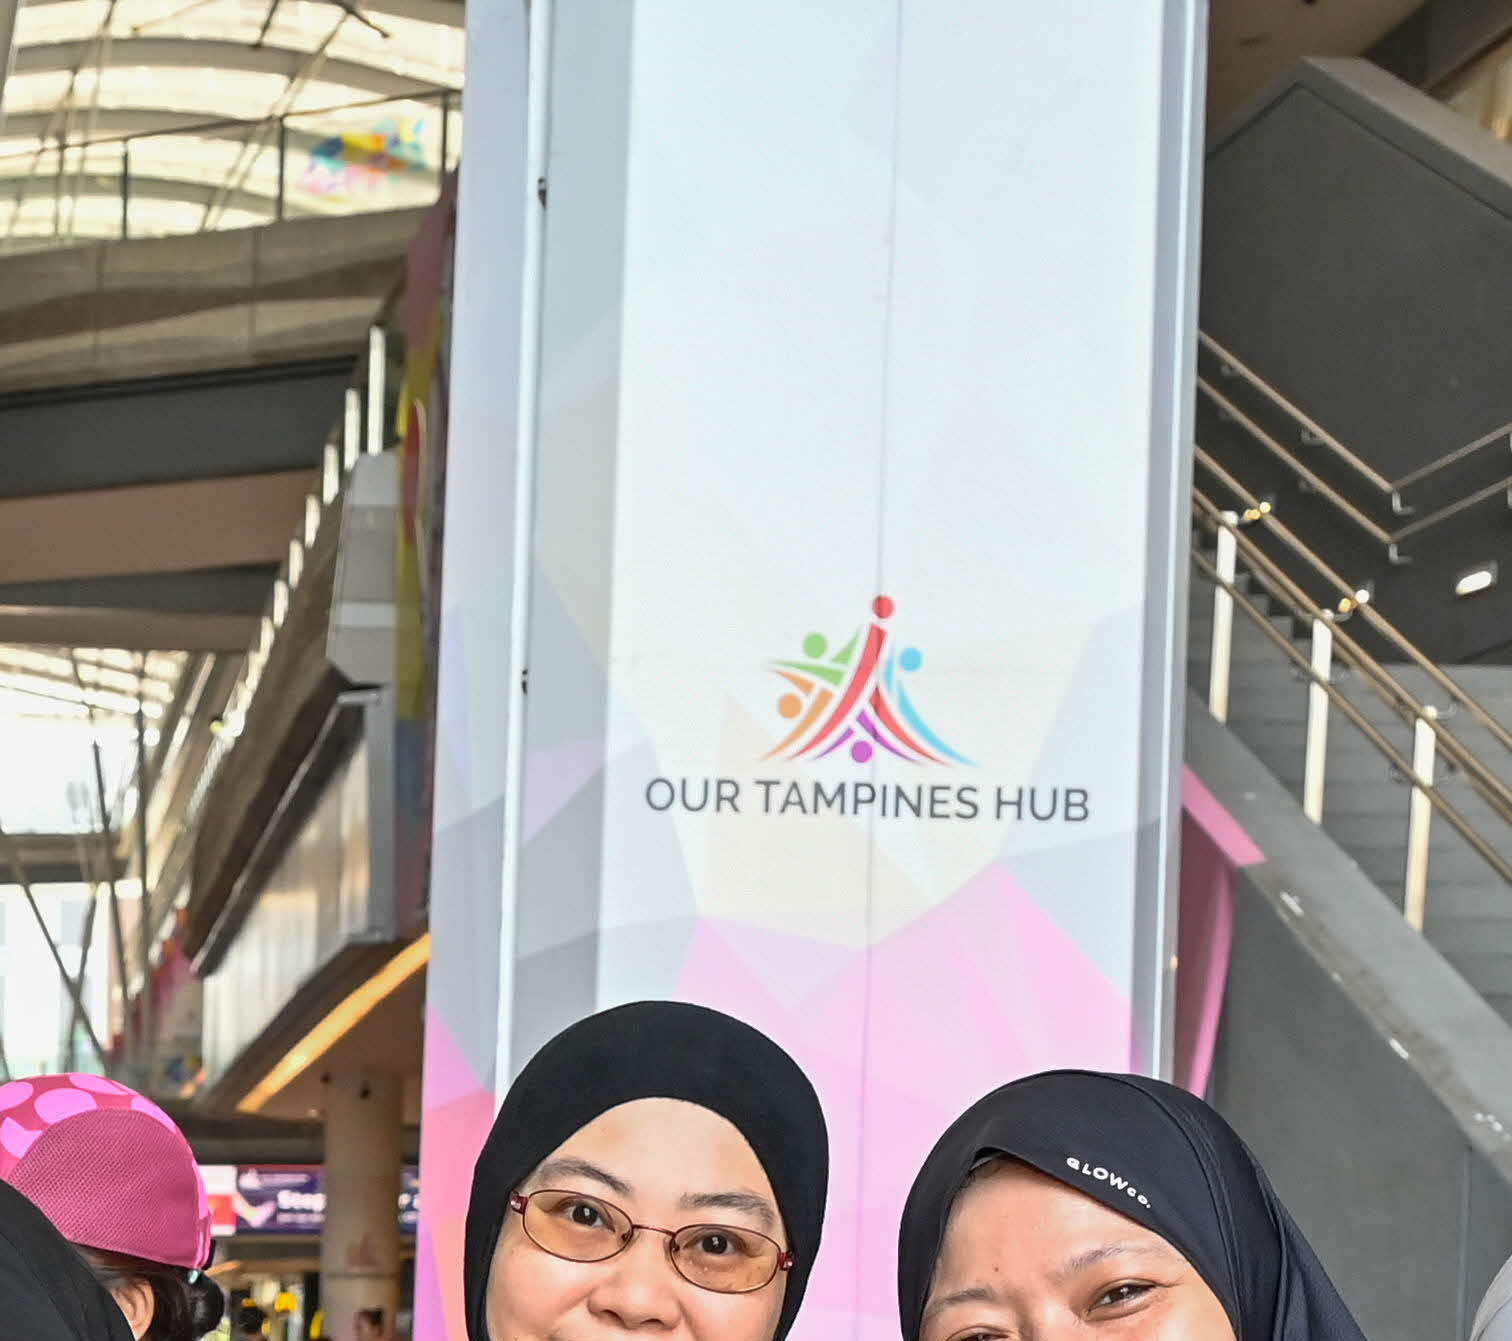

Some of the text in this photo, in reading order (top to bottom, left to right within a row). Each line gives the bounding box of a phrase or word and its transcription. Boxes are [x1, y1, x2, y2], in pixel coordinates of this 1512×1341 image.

[644, 778, 1090, 823] OUR TAMPINES HUB
